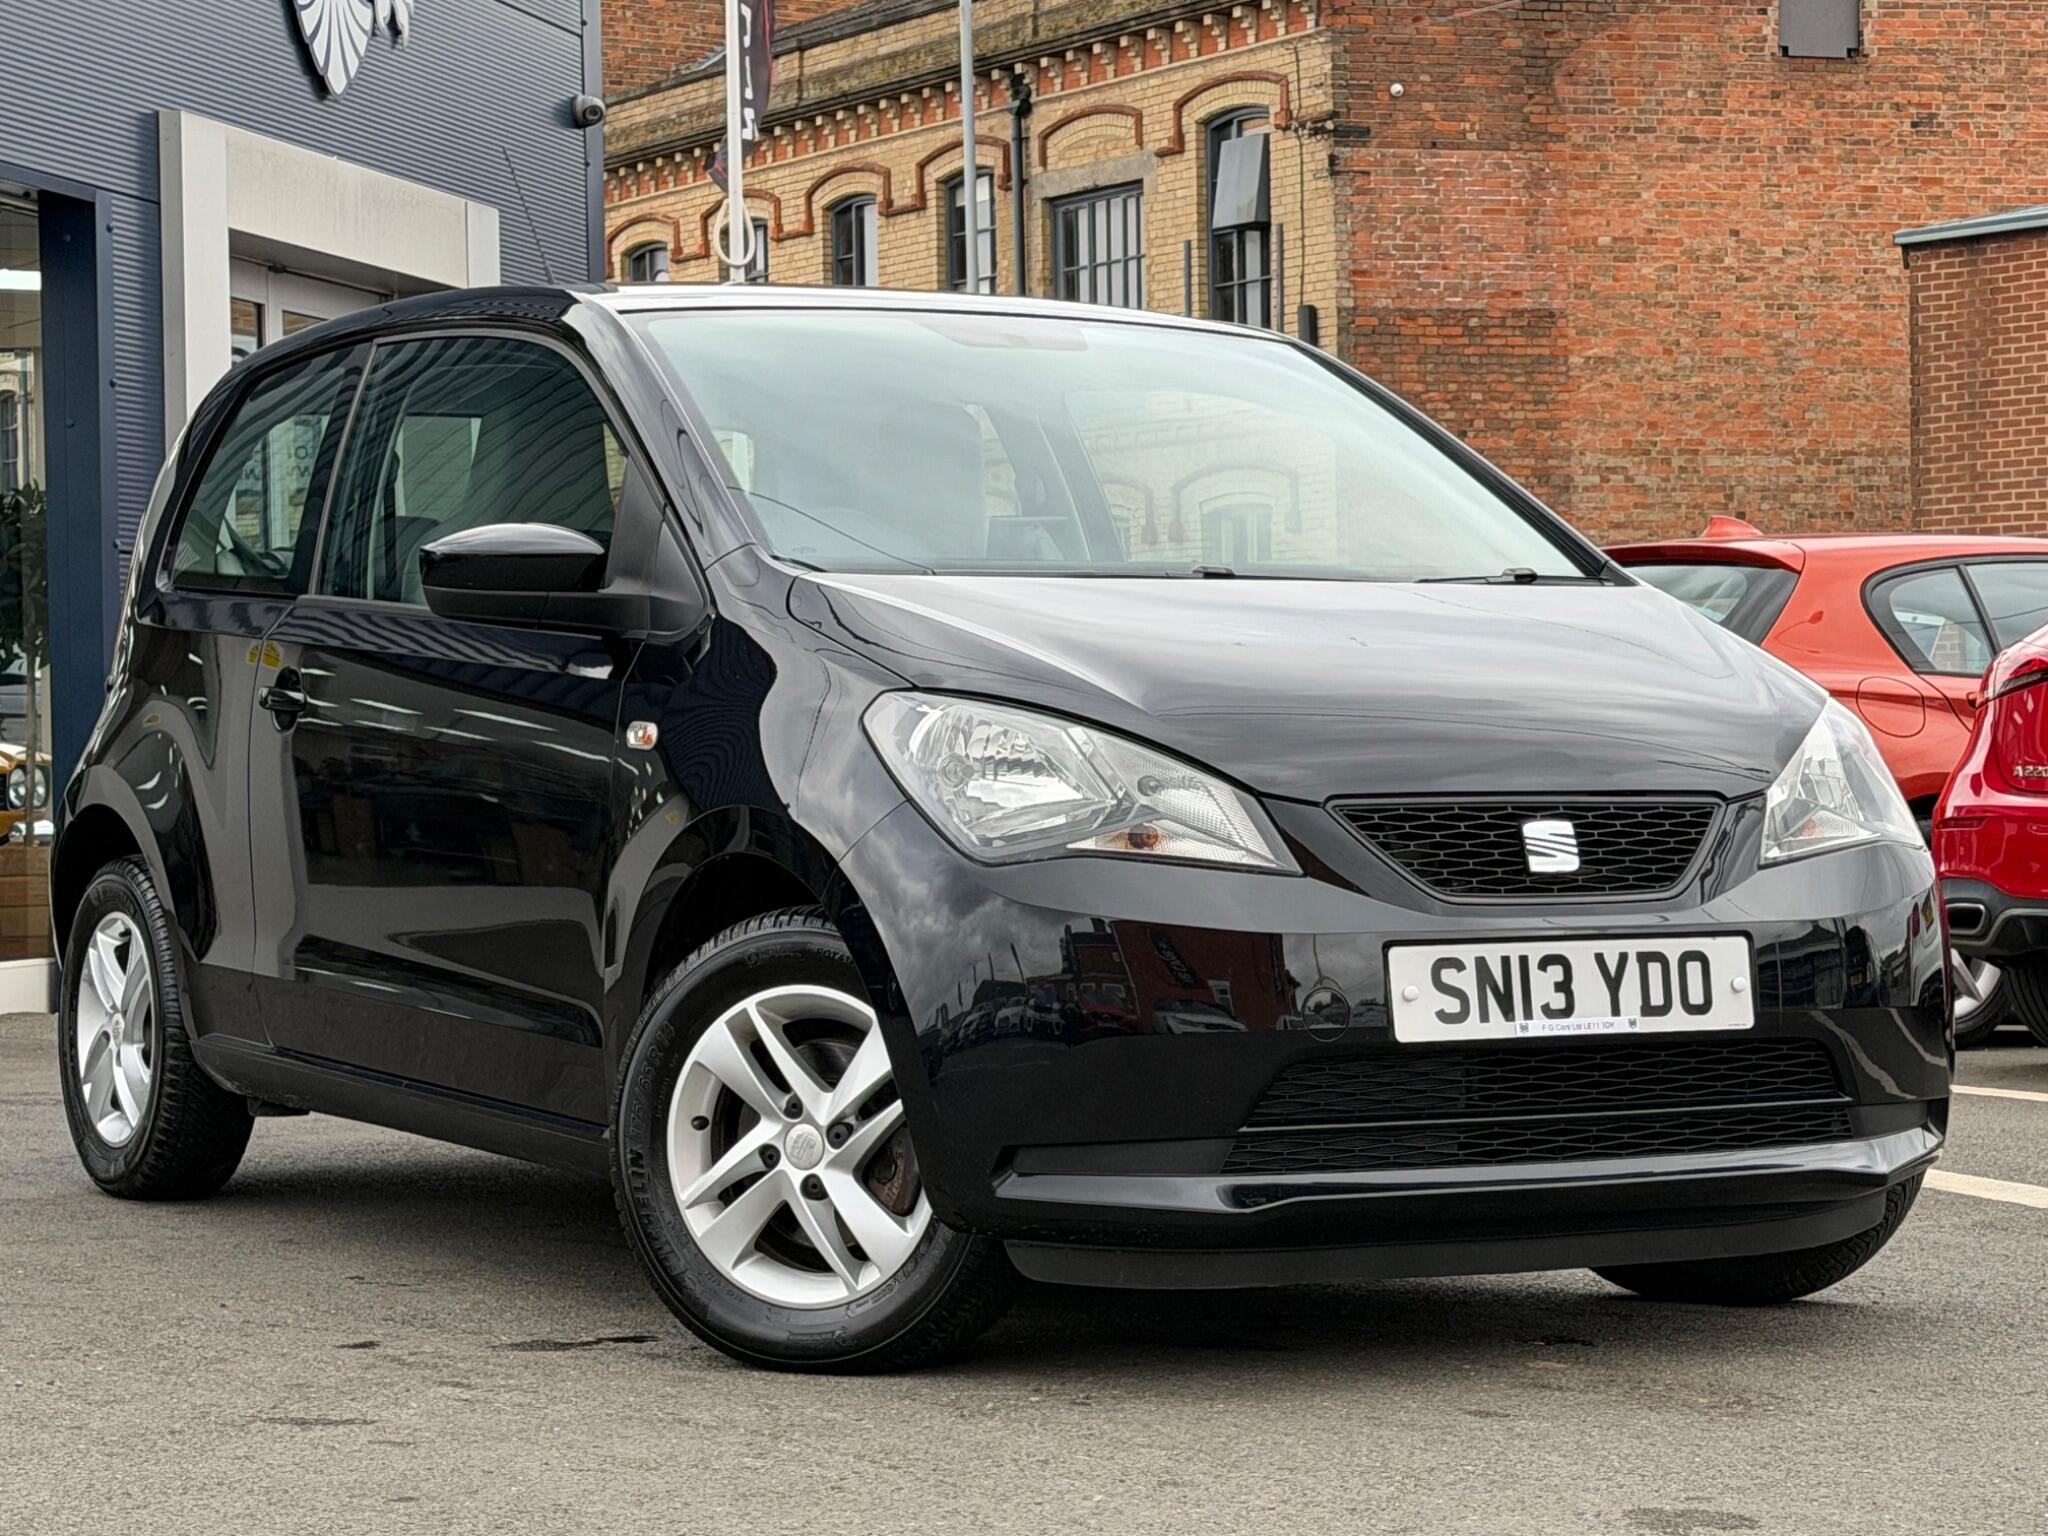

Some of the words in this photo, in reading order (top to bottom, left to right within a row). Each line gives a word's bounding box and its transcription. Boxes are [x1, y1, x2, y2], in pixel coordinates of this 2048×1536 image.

[2013, 765, 2048, 777] A220
[1430, 953, 1575, 1025] SN13
[1594, 949, 1713, 1018] YDO
